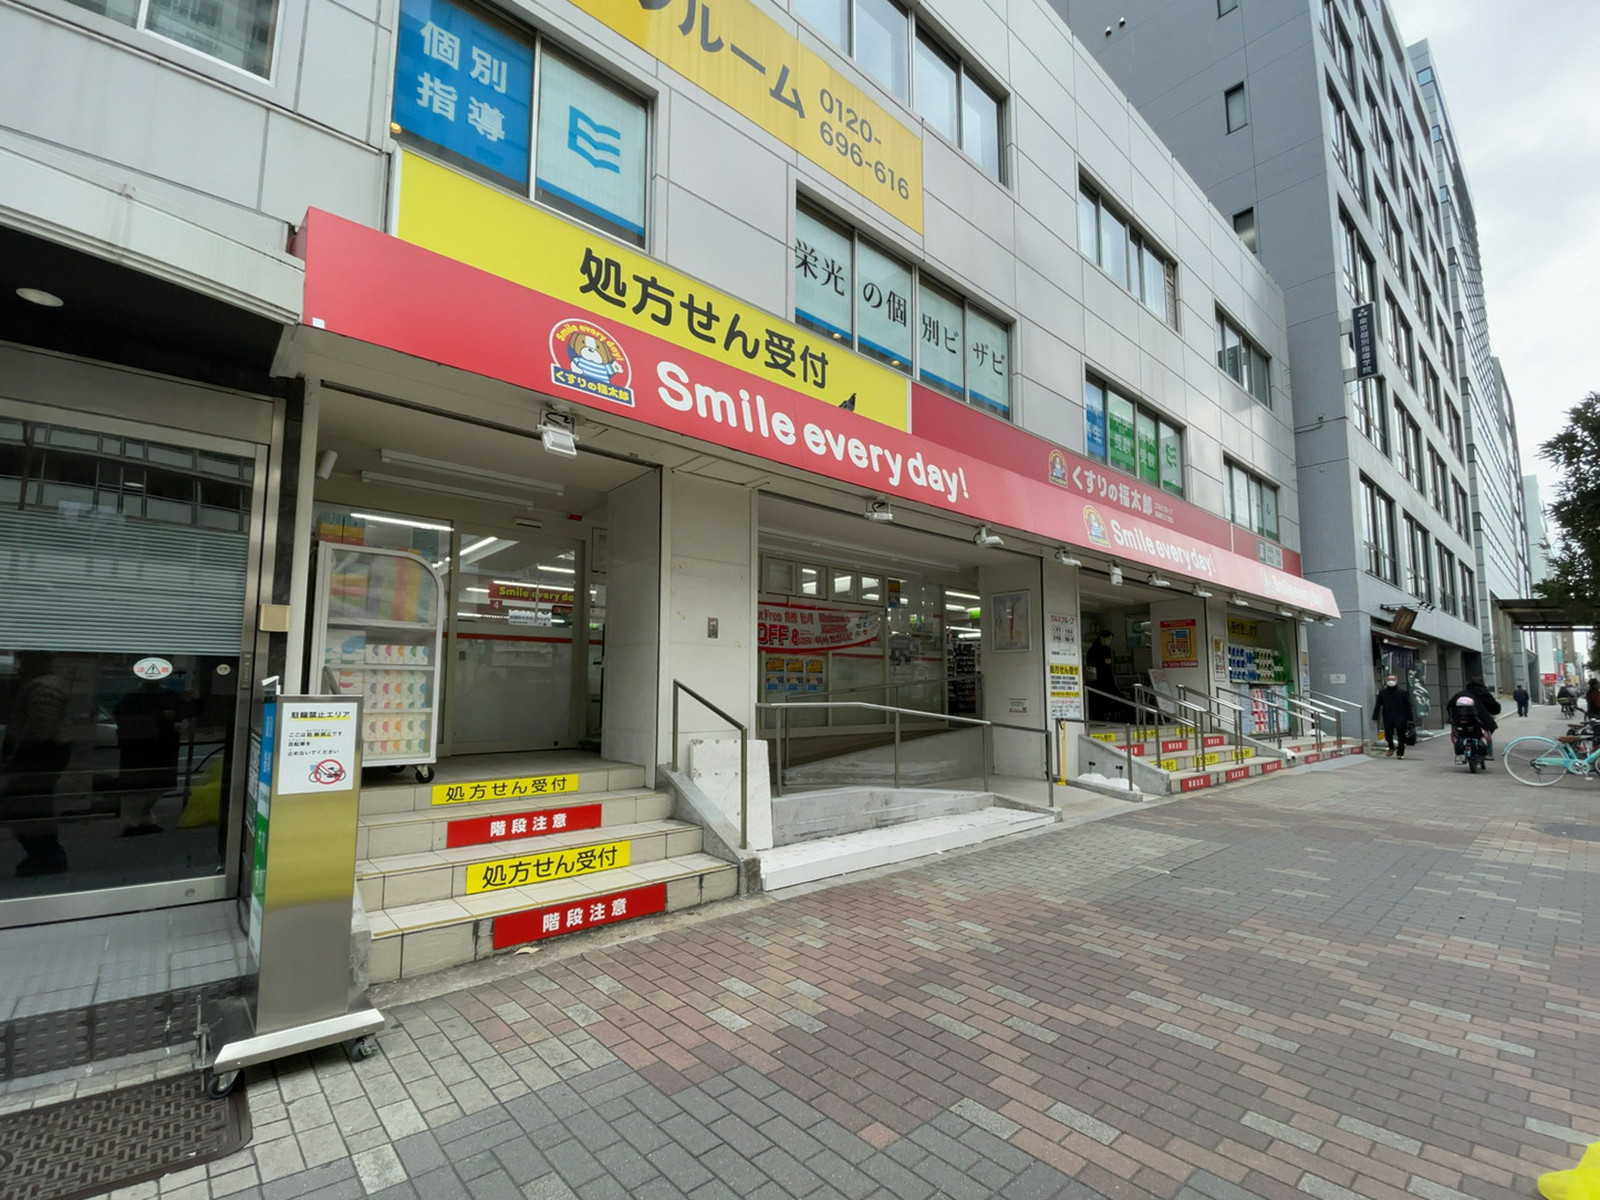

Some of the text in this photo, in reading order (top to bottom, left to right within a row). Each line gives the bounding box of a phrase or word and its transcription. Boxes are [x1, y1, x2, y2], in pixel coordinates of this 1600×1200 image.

[420, 20, 507, 94] 個別
[640, 0, 806, 119] ルーム
[416, 72, 505, 142] 指導
[819, 87, 882, 146] 0120-
[819, 121, 910, 201] 696-616
[579, 247, 829, 389] 処方せん受付
[555, 371, 630, 402] くすりの福太郎
[656, 361, 969, 503] Smile every day!
[1072, 466, 1152, 516] くすりの福太郎
[1110, 519, 1156, 556] Smile
[1155, 541, 1193, 571] every
[1191, 547, 1217, 577] day!
[493, 601, 499, 609] 4
[499, 586, 529, 598] Smile
[758, 623, 789, 645] OFF
[291, 711, 350, 719] 駐輪禁止エリア
[446, 777, 568, 803] 処方せん受付
[490, 813, 567, 838] 階段注意
[482, 845, 618, 889] 処方せん受付
[542, 898, 627, 934] 階段注意
